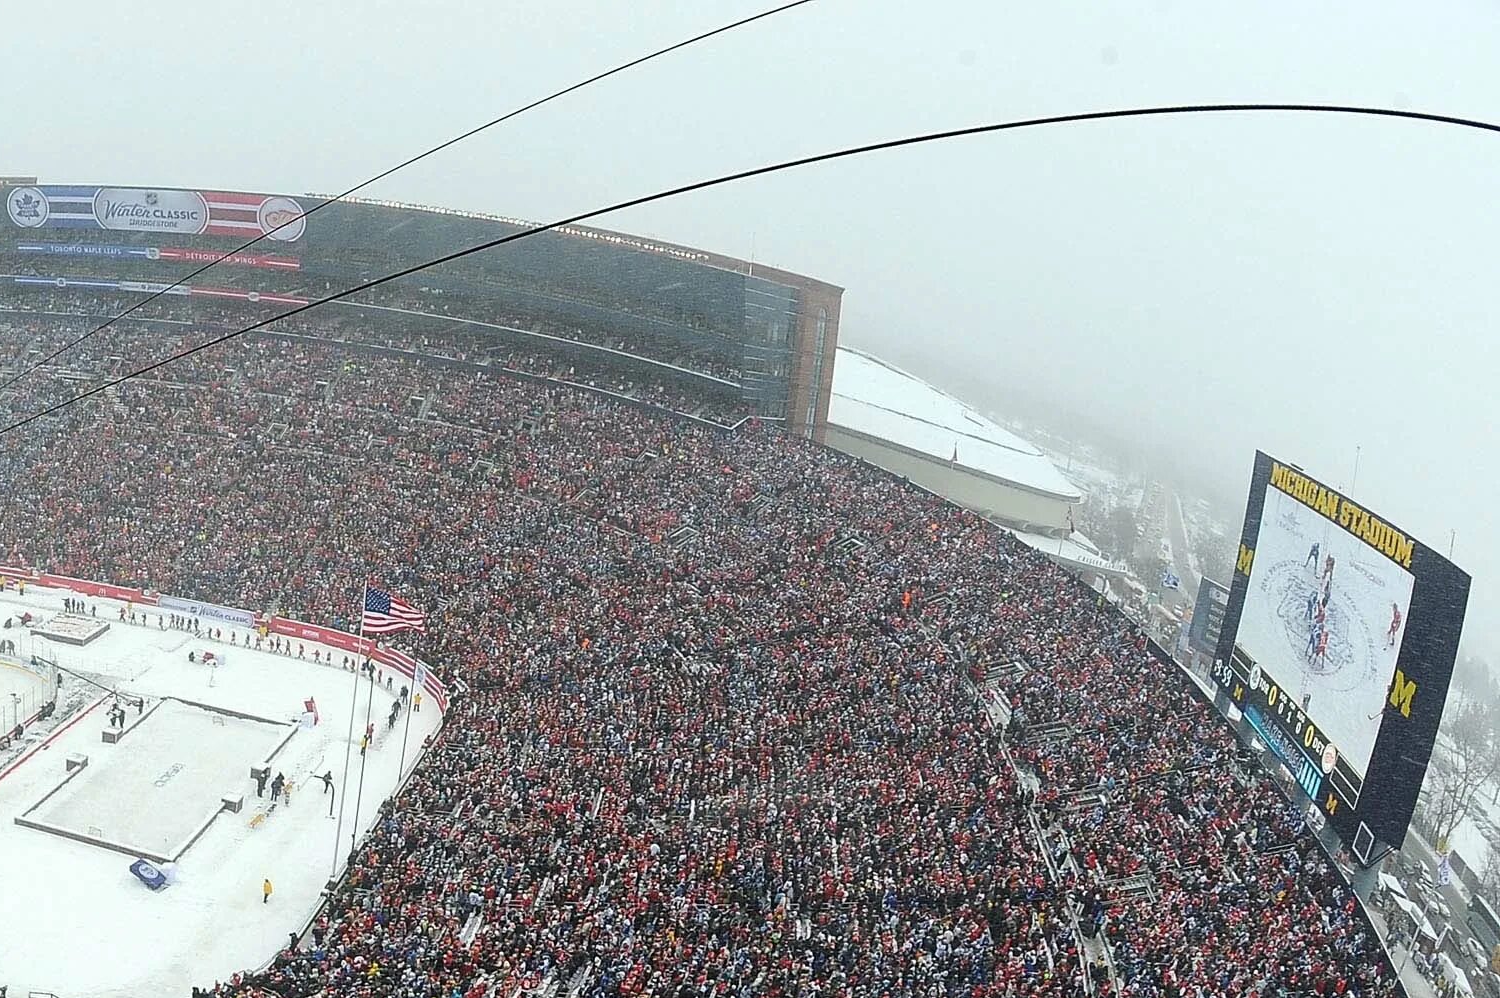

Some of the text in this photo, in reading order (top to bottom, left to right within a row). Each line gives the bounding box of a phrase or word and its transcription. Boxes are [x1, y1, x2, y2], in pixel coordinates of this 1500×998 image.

[104, 200, 198, 220] Winter CLASSIC
[129, 218, 178, 228] BRIDGESTONE
[185, 252, 216, 260] DETROIT
[234, 257, 257, 265] WINGS
[1270, 462, 1416, 568] MICHIGAN STADIUM
[1237, 544, 1254, 577] M
[1268, 685, 1278, 706] 0
[1389, 669, 1417, 718] M
[1304, 724, 1325, 756] 0 DET
